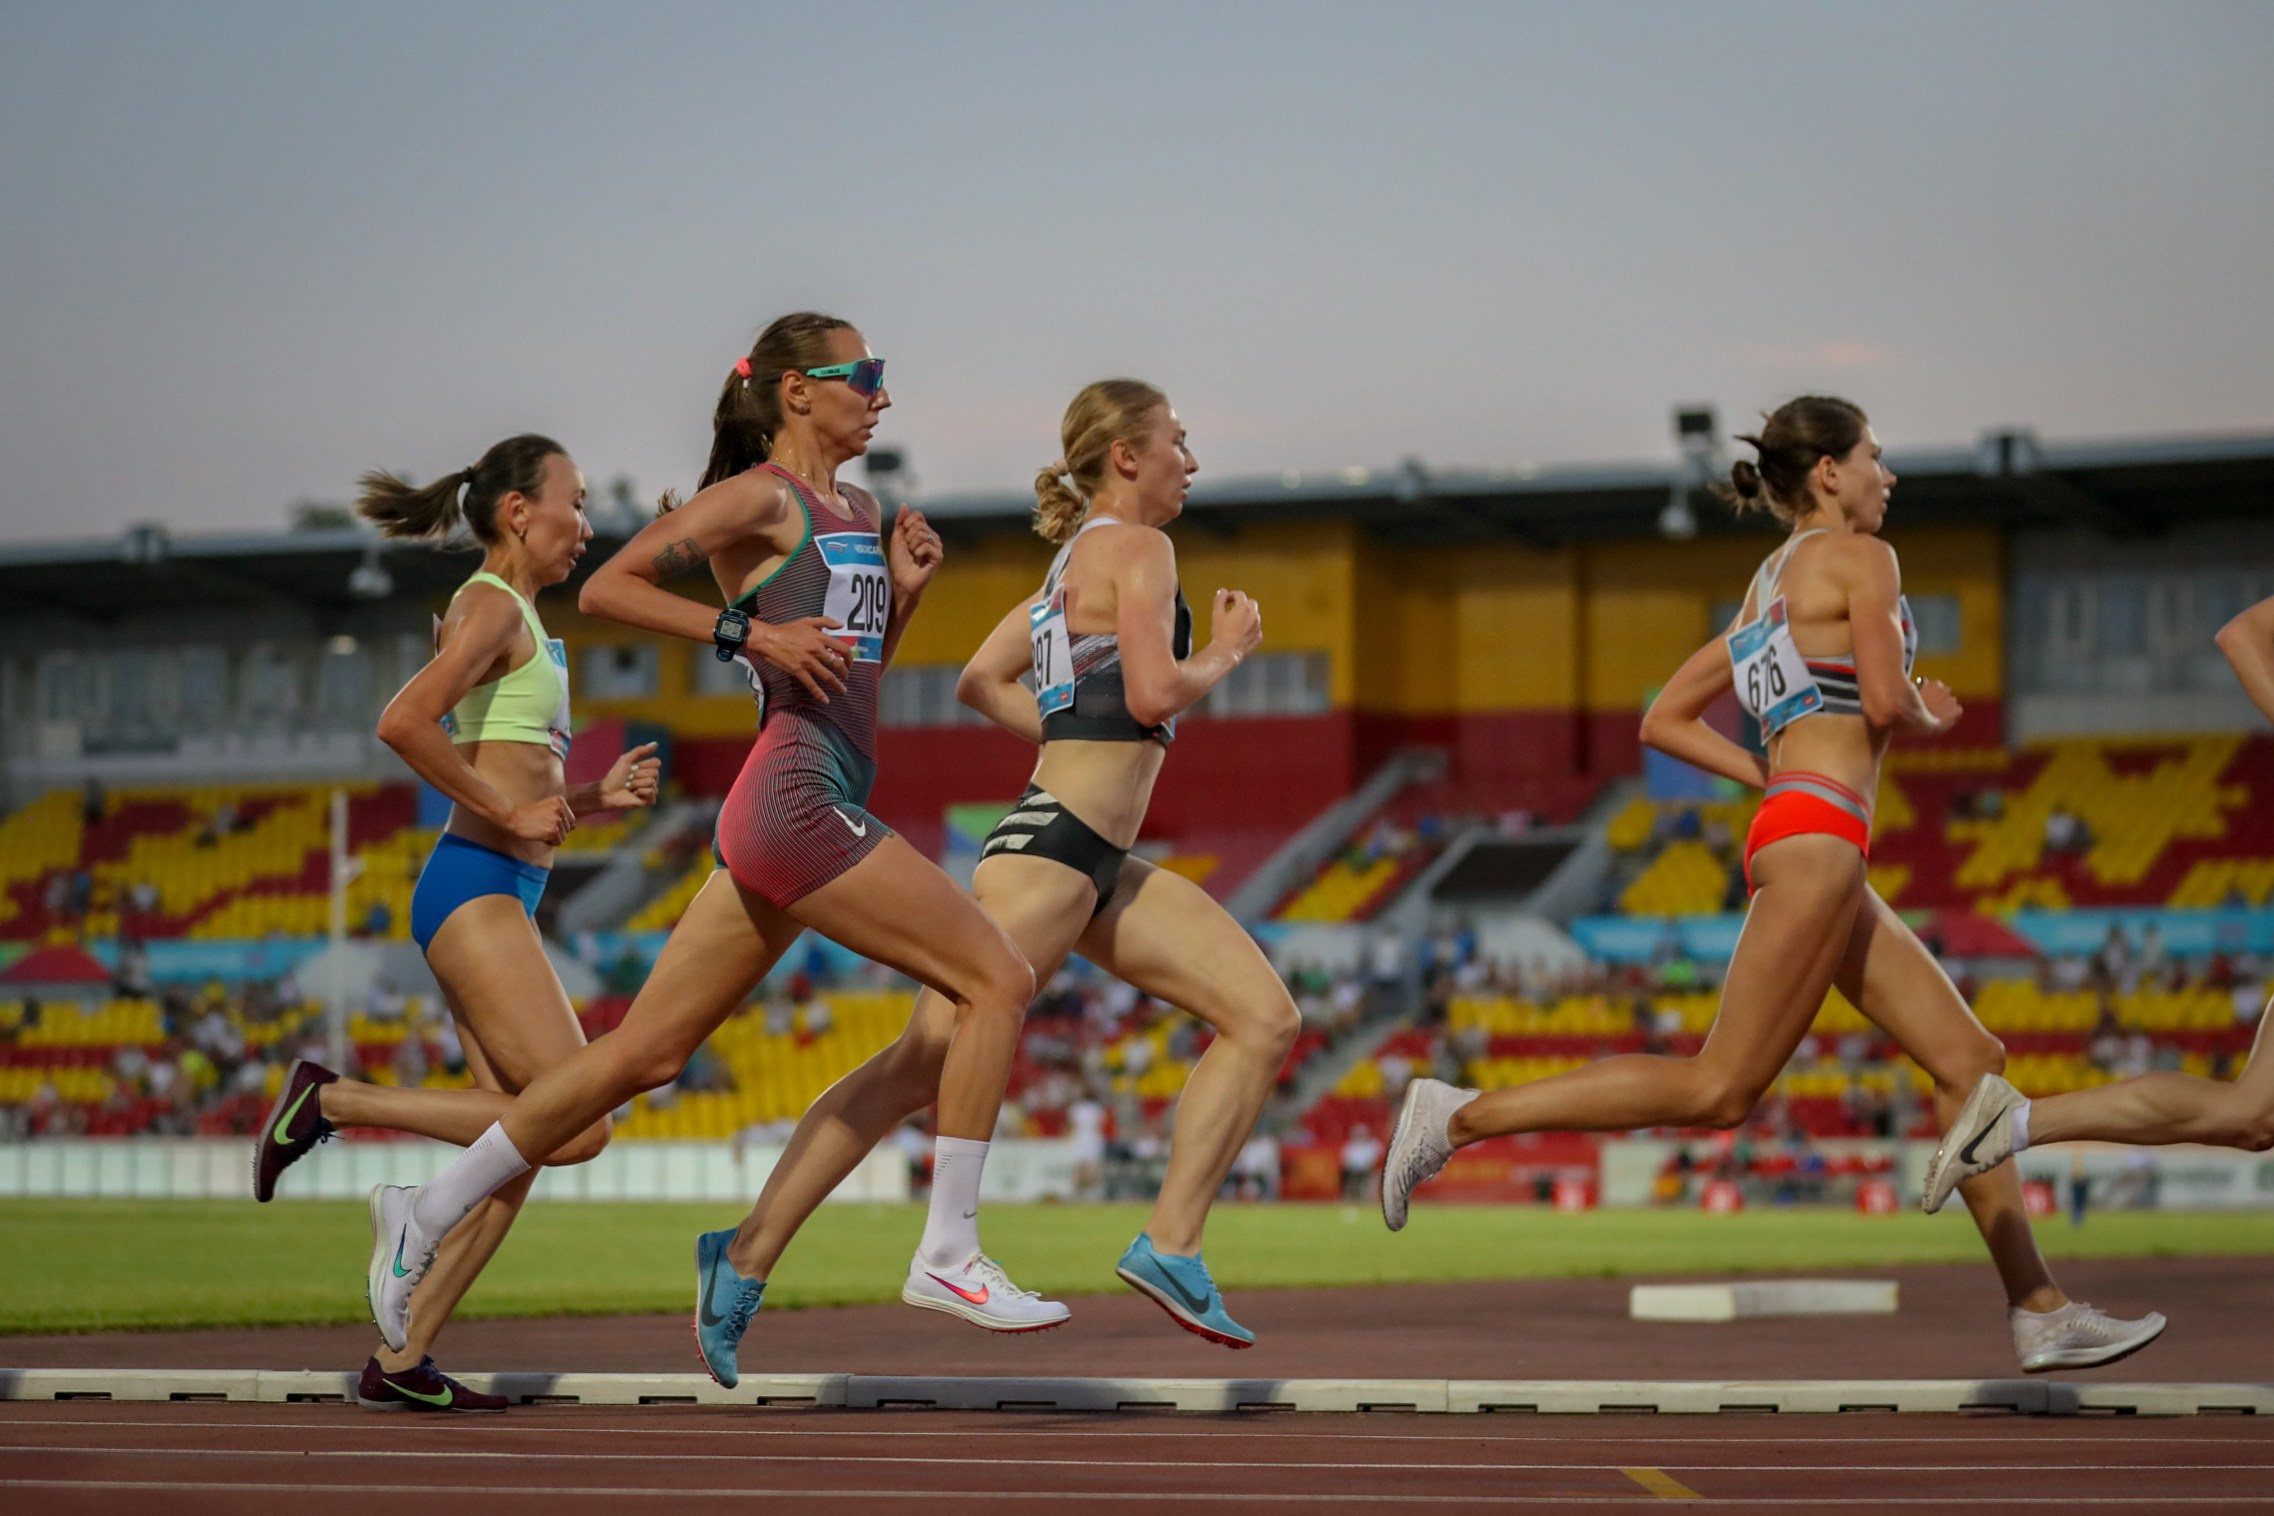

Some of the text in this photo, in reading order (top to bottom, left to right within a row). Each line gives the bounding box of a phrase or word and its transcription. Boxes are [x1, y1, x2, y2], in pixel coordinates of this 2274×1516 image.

[847, 573, 886, 634] 209
[1031, 628, 1053, 690] 97
[1747, 643, 1787, 714] 676
